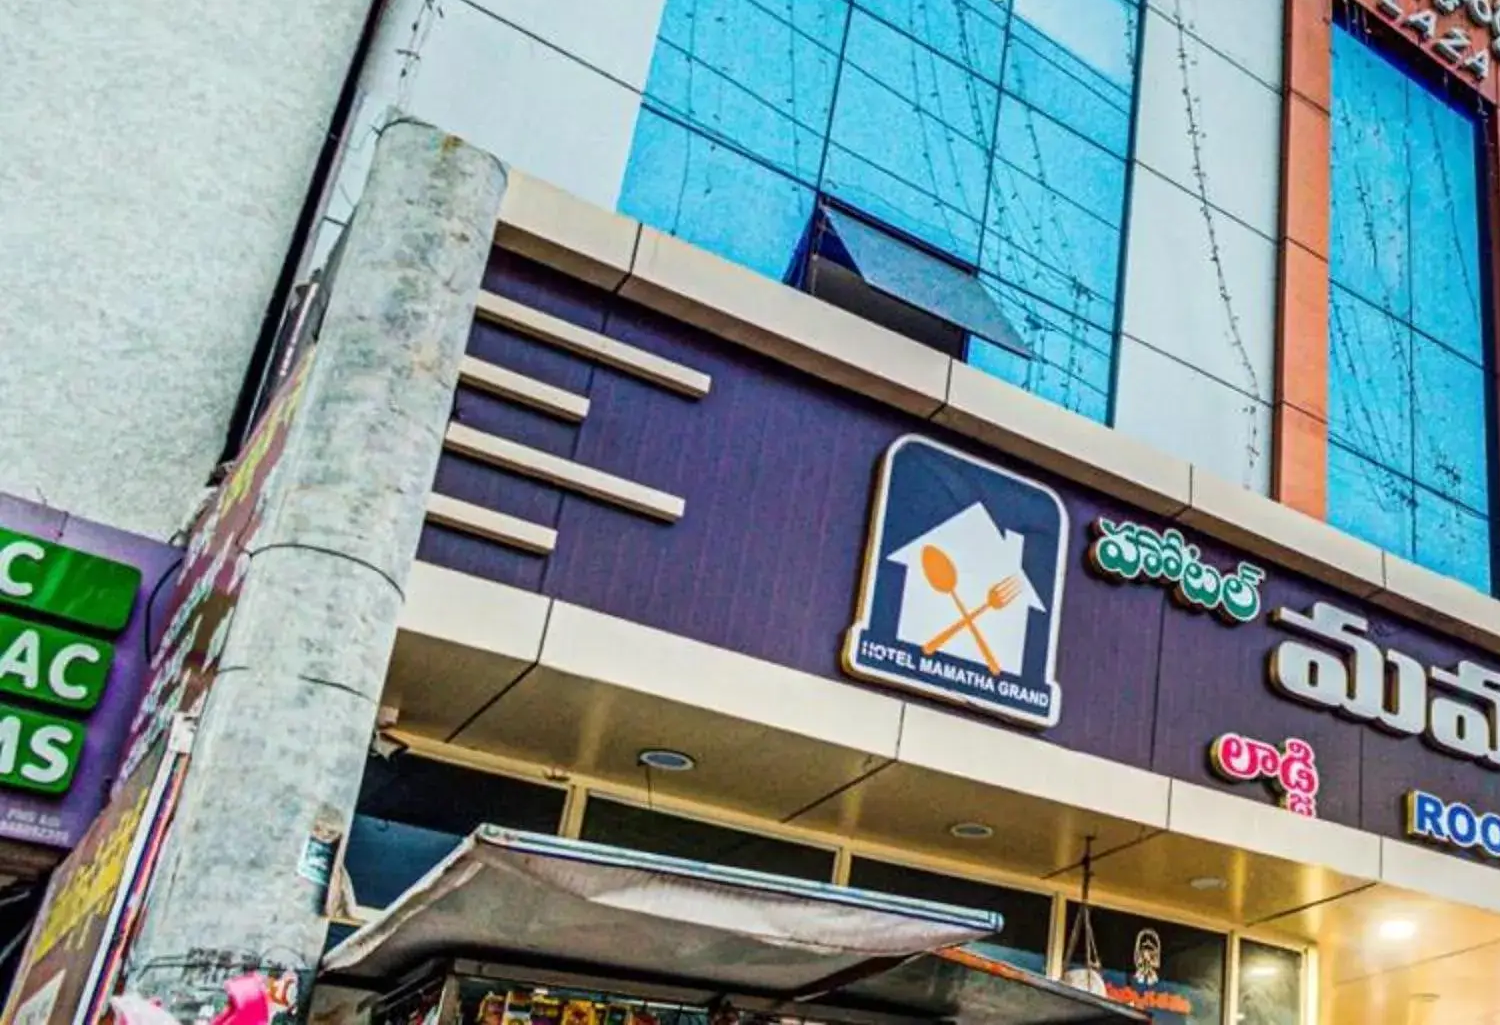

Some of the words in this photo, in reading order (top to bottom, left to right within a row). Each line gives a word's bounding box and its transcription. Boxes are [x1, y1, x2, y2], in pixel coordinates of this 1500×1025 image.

[1096, 516, 1266, 621] హోటల్
[860, 640, 916, 671] HOTEL
[919, 658, 995, 692] MAMATHA
[997, 681, 1050, 709] GRAND
